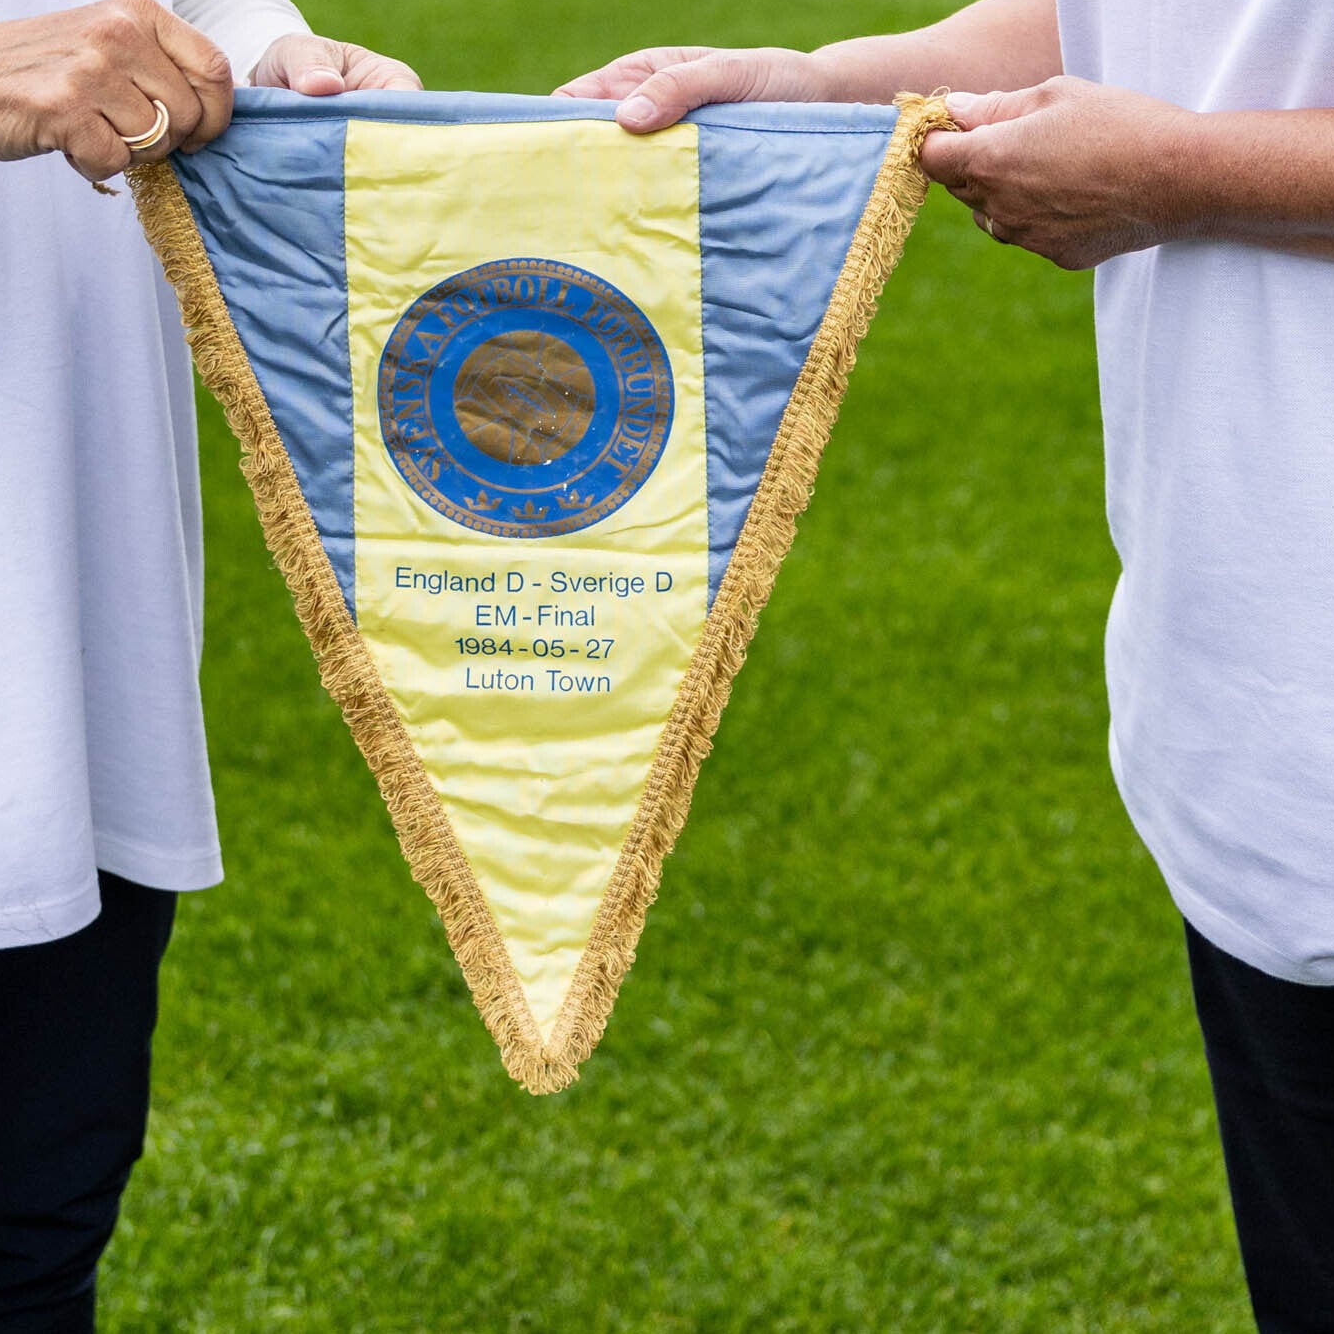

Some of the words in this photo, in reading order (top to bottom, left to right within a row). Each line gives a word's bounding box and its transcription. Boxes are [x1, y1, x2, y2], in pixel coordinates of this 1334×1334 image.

[394, 330, 450, 482] SVENSKA
[435, 275, 576, 330] FOTBOLL
[395, 566, 496, 595] England
[506, 572, 525, 593] D
[550, 571, 645, 598] Sverige
[655, 571, 674, 593] D
[465, 667, 534, 691] Luton
[546, 670, 611, 693] Town
